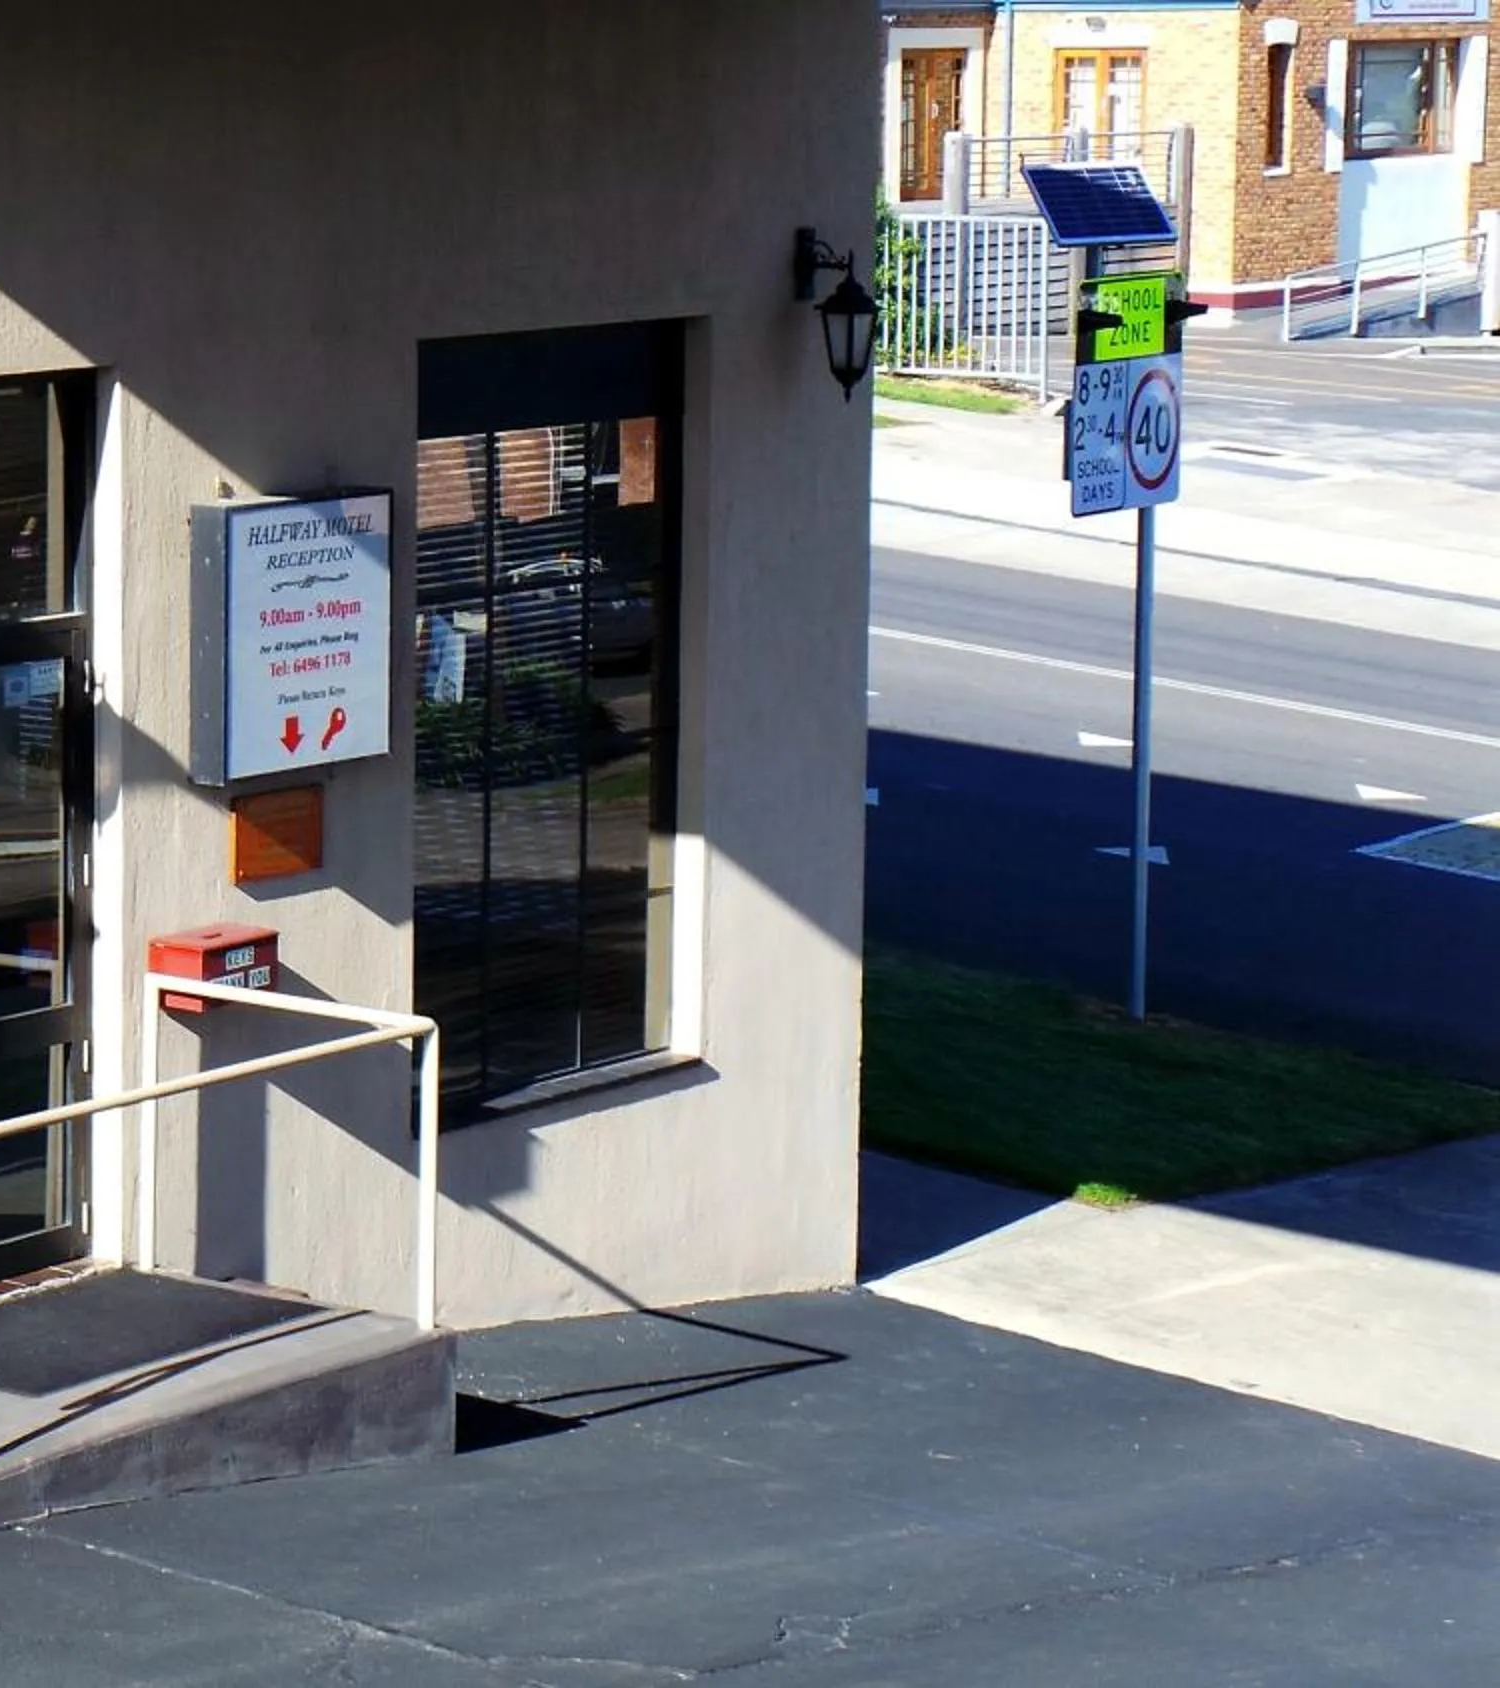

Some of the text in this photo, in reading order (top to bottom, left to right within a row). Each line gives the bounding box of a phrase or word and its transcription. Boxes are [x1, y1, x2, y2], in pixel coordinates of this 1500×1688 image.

[1110, 321, 1152, 347] ZONE
[1135, 405, 1171, 456] 40
[1077, 459, 1120, 479] SCHOOL
[1082, 482, 1115, 503] DAYS
[247, 513, 373, 547] HALFWAY MOTEL
[265, 544, 355, 570] RECEPTION
[260, 607, 305, 628] 9.00am
[316, 600, 361, 620] 9.00pm
[269, 659, 290, 678] Tel:
[294, 656, 321, 673] 6496
[227, 949, 253, 966] KEYS
